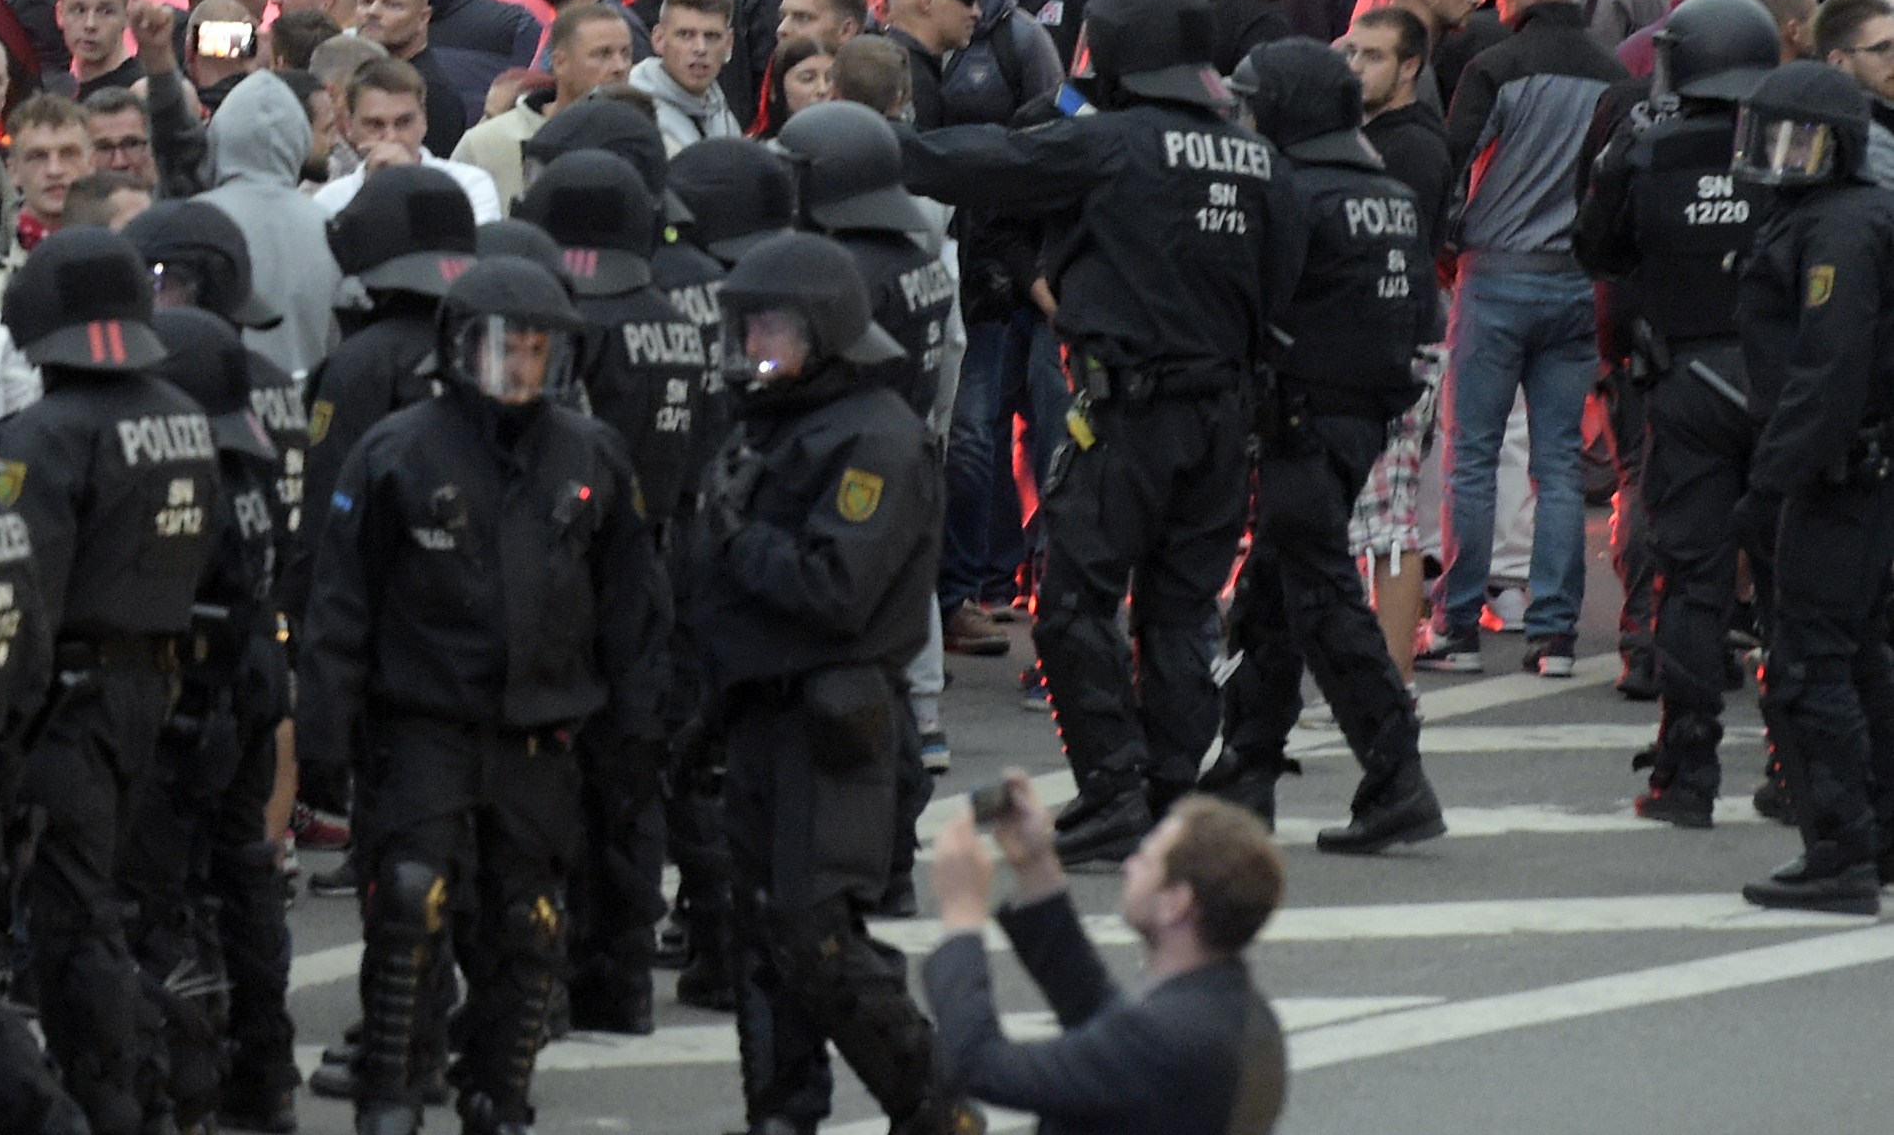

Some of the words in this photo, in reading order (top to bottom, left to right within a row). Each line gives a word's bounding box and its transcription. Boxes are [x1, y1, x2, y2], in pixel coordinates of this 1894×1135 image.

[1164, 131, 1272, 181] POLIZEI
[1209, 182, 1238, 207] SN
[1697, 175, 1734, 199] SN
[1684, 200, 1751, 225] 12/20
[116, 414, 215, 467] POLIZEI
